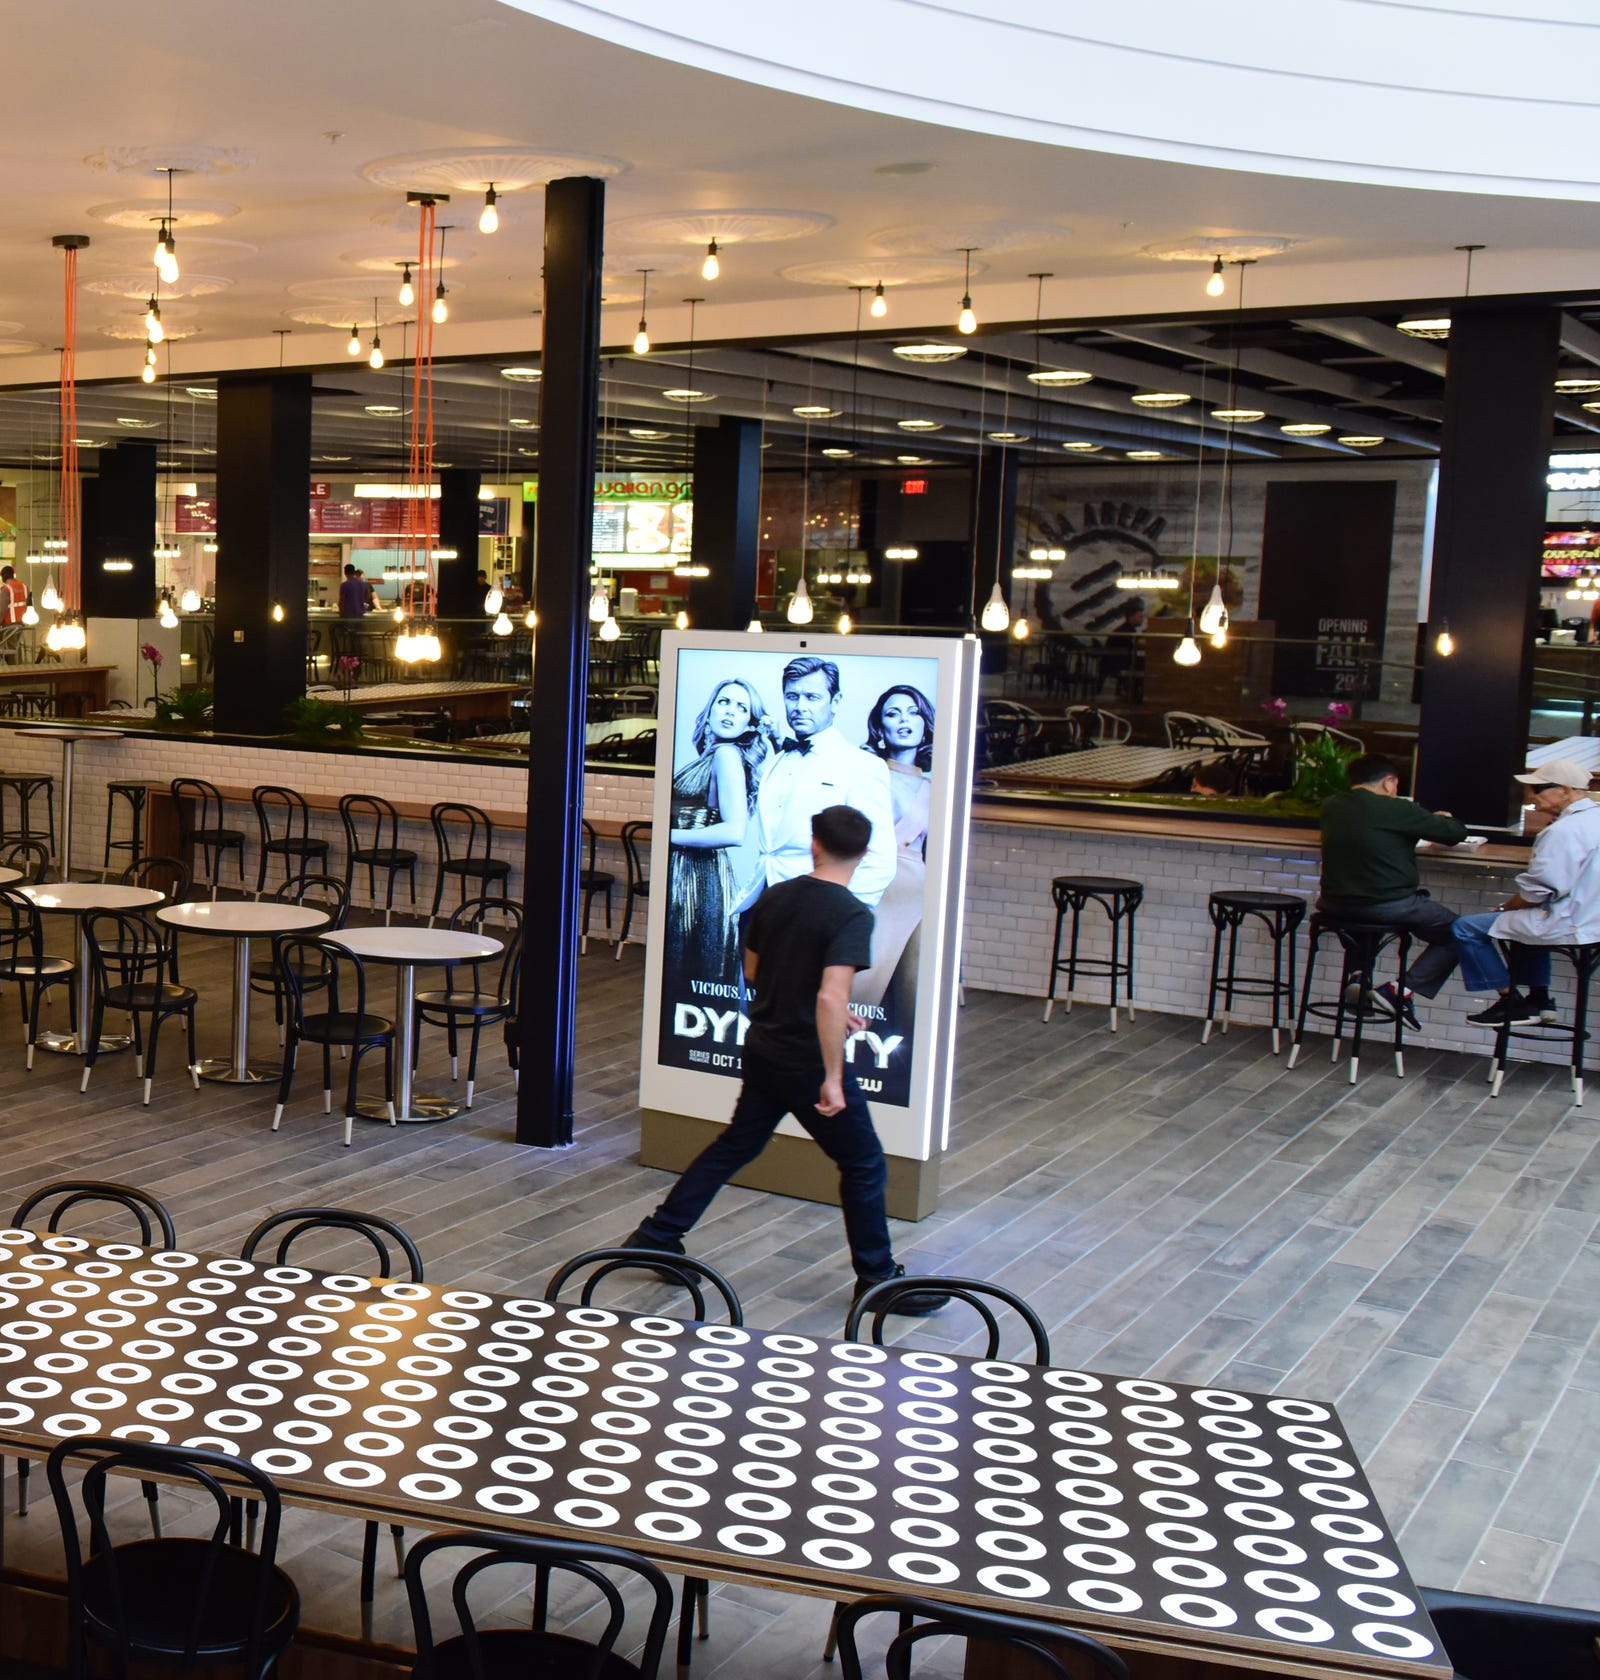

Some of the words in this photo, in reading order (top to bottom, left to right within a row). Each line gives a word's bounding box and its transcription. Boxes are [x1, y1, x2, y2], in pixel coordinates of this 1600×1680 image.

[1317, 617, 1368, 634] OPENING
[690, 979, 741, 1000] VICIOUS.
[712, 1053, 735, 1068] OCT
